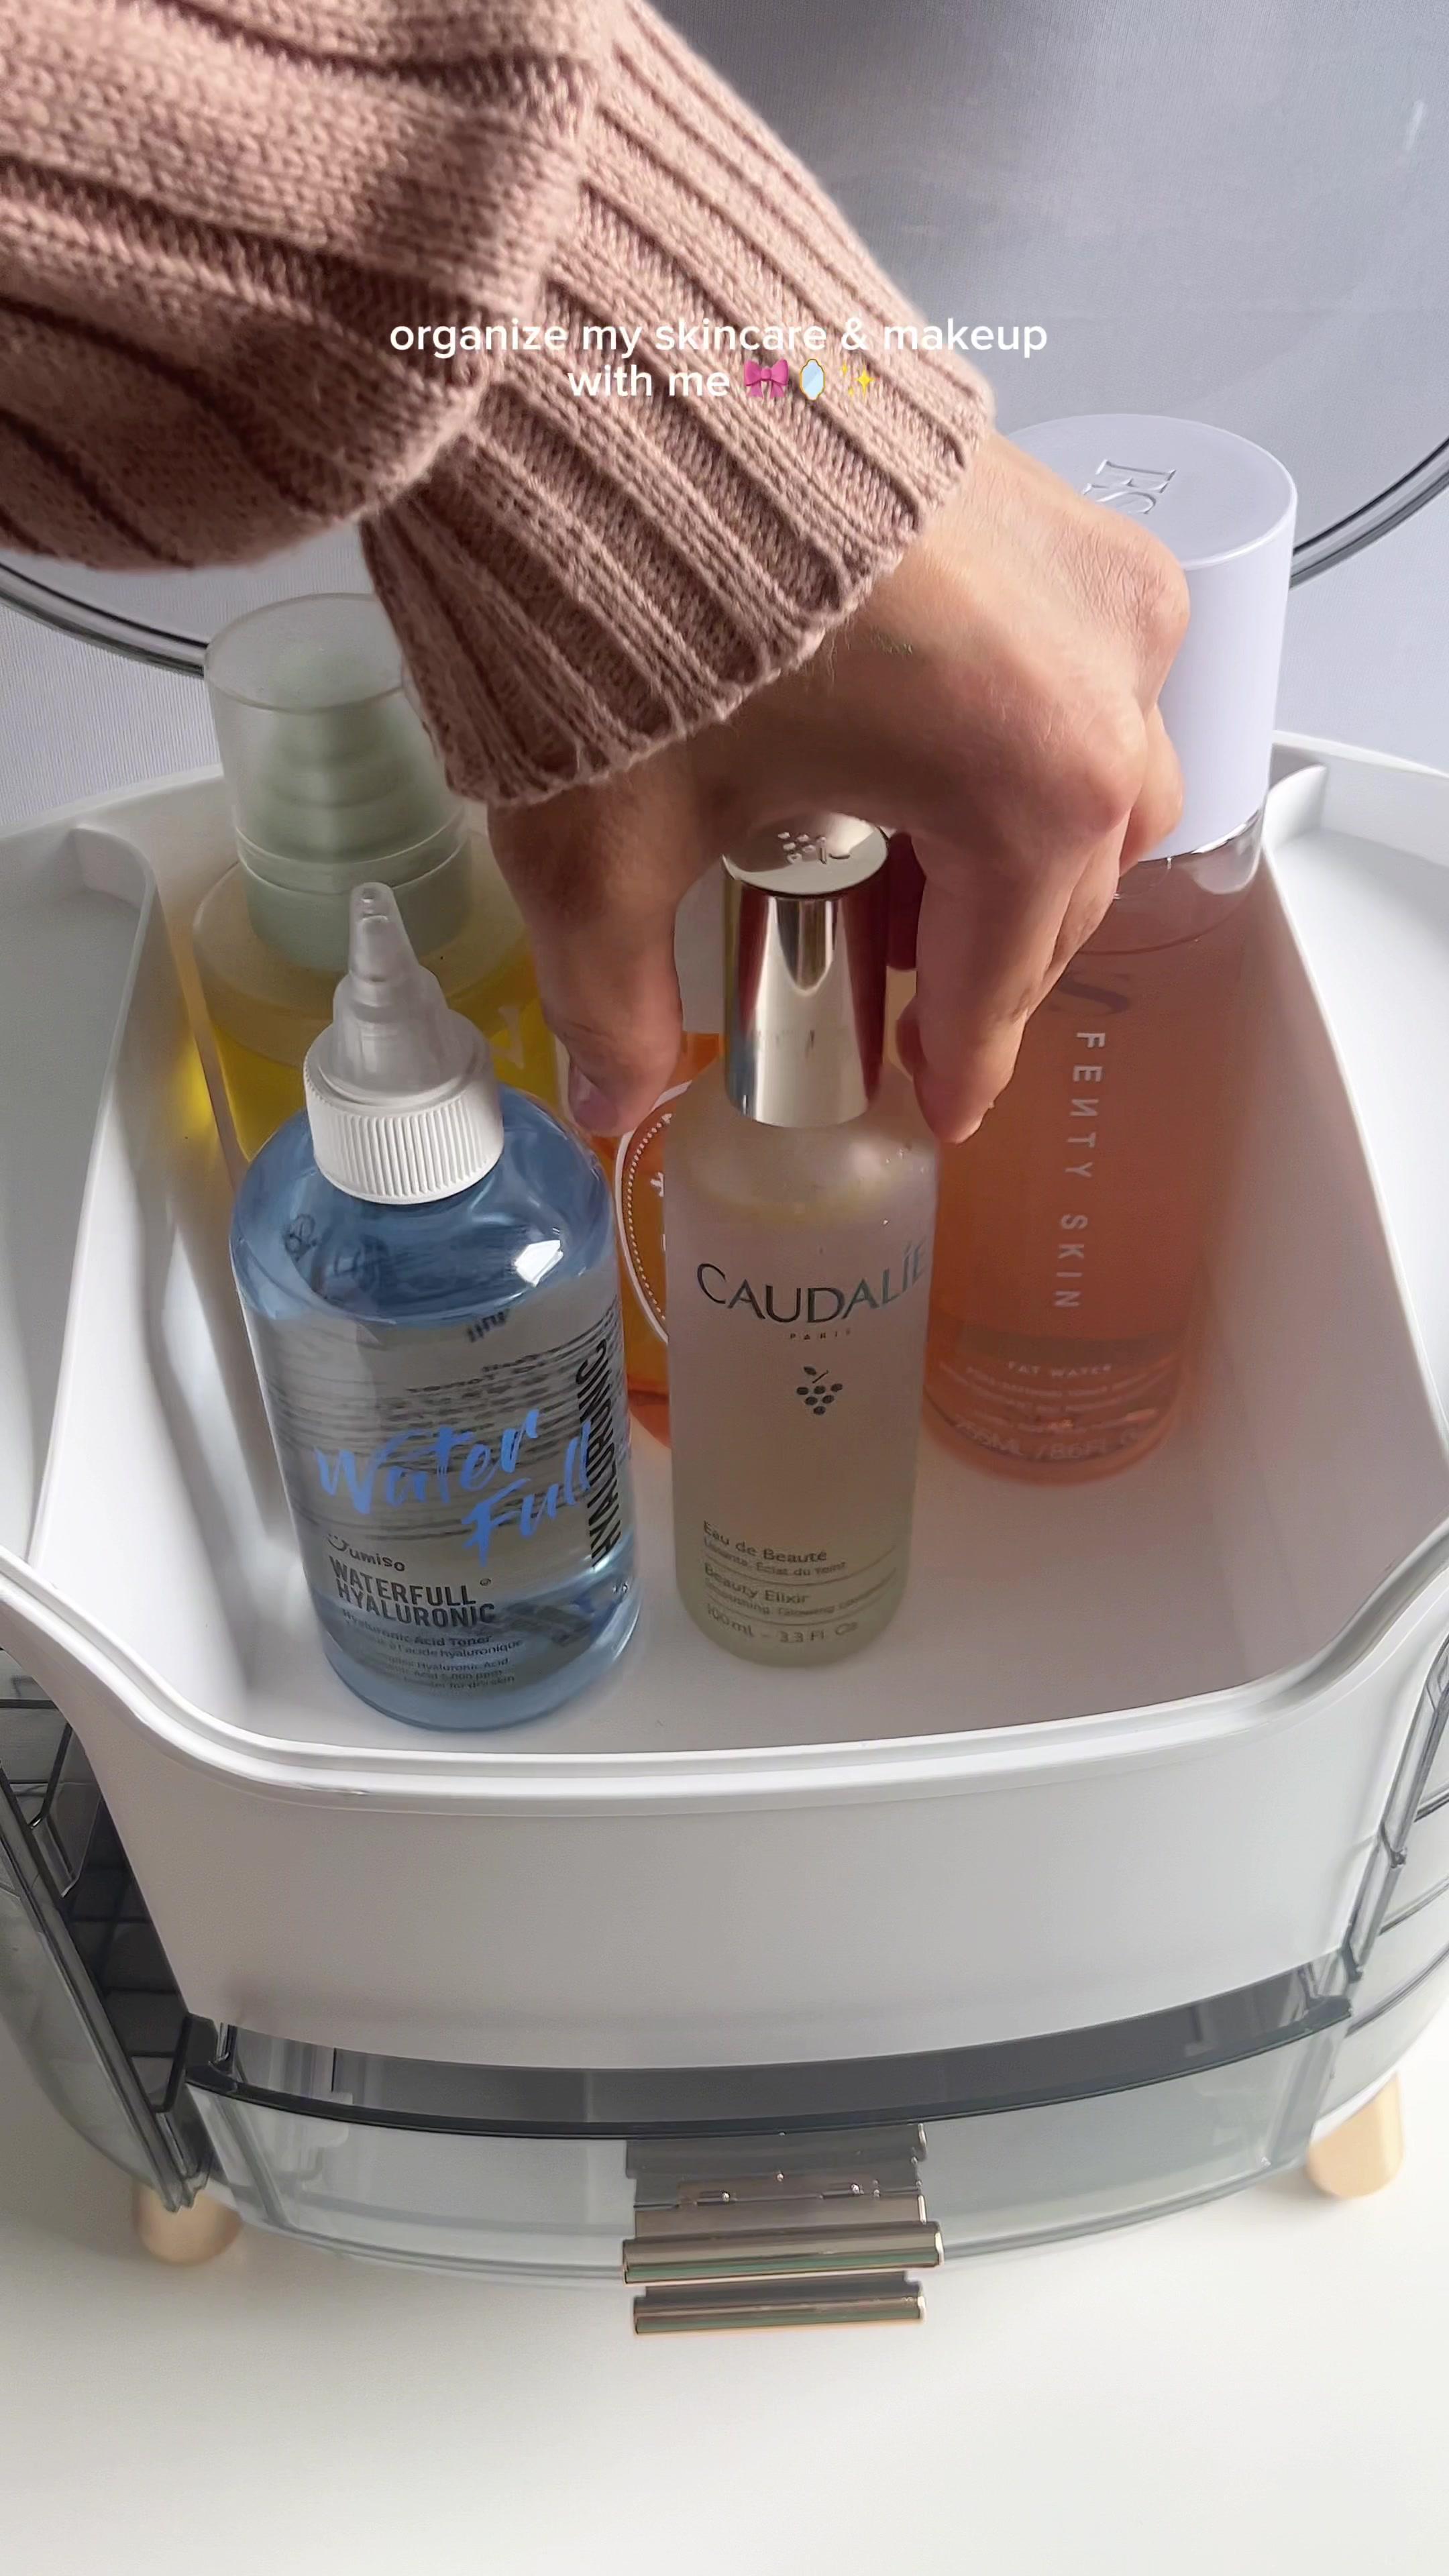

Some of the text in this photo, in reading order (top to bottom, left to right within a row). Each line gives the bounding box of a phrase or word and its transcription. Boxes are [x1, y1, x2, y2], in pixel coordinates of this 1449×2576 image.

[1054, 1032, 1106, 1308] FENTY SKIN
[790, 1328, 851, 1341] PARIS
[1008, 1360, 1112, 1378] FAT WATER
[312, 1409, 540, 1515] Water
[576, 1338, 622, 1570] HYALURONIC
[461, 1419, 592, 1568] Full
[735, 1541, 757, 1557] de
[763, 1547, 828, 1563] Beauté
[328, 1554, 477, 1607] WATERFULL
[704, 1562, 812, 1605] Beauty Elixir
[335, 1577, 496, 1628] HYALURONIC
[414, 1635, 445, 1647] Acid
[449, 1635, 492, 1647] Toner
[439, 1640, 523, 1659] hyaluronique
[417, 1662, 478, 1672] Hyaluronic
[484, 1657, 509, 1668] Acid
